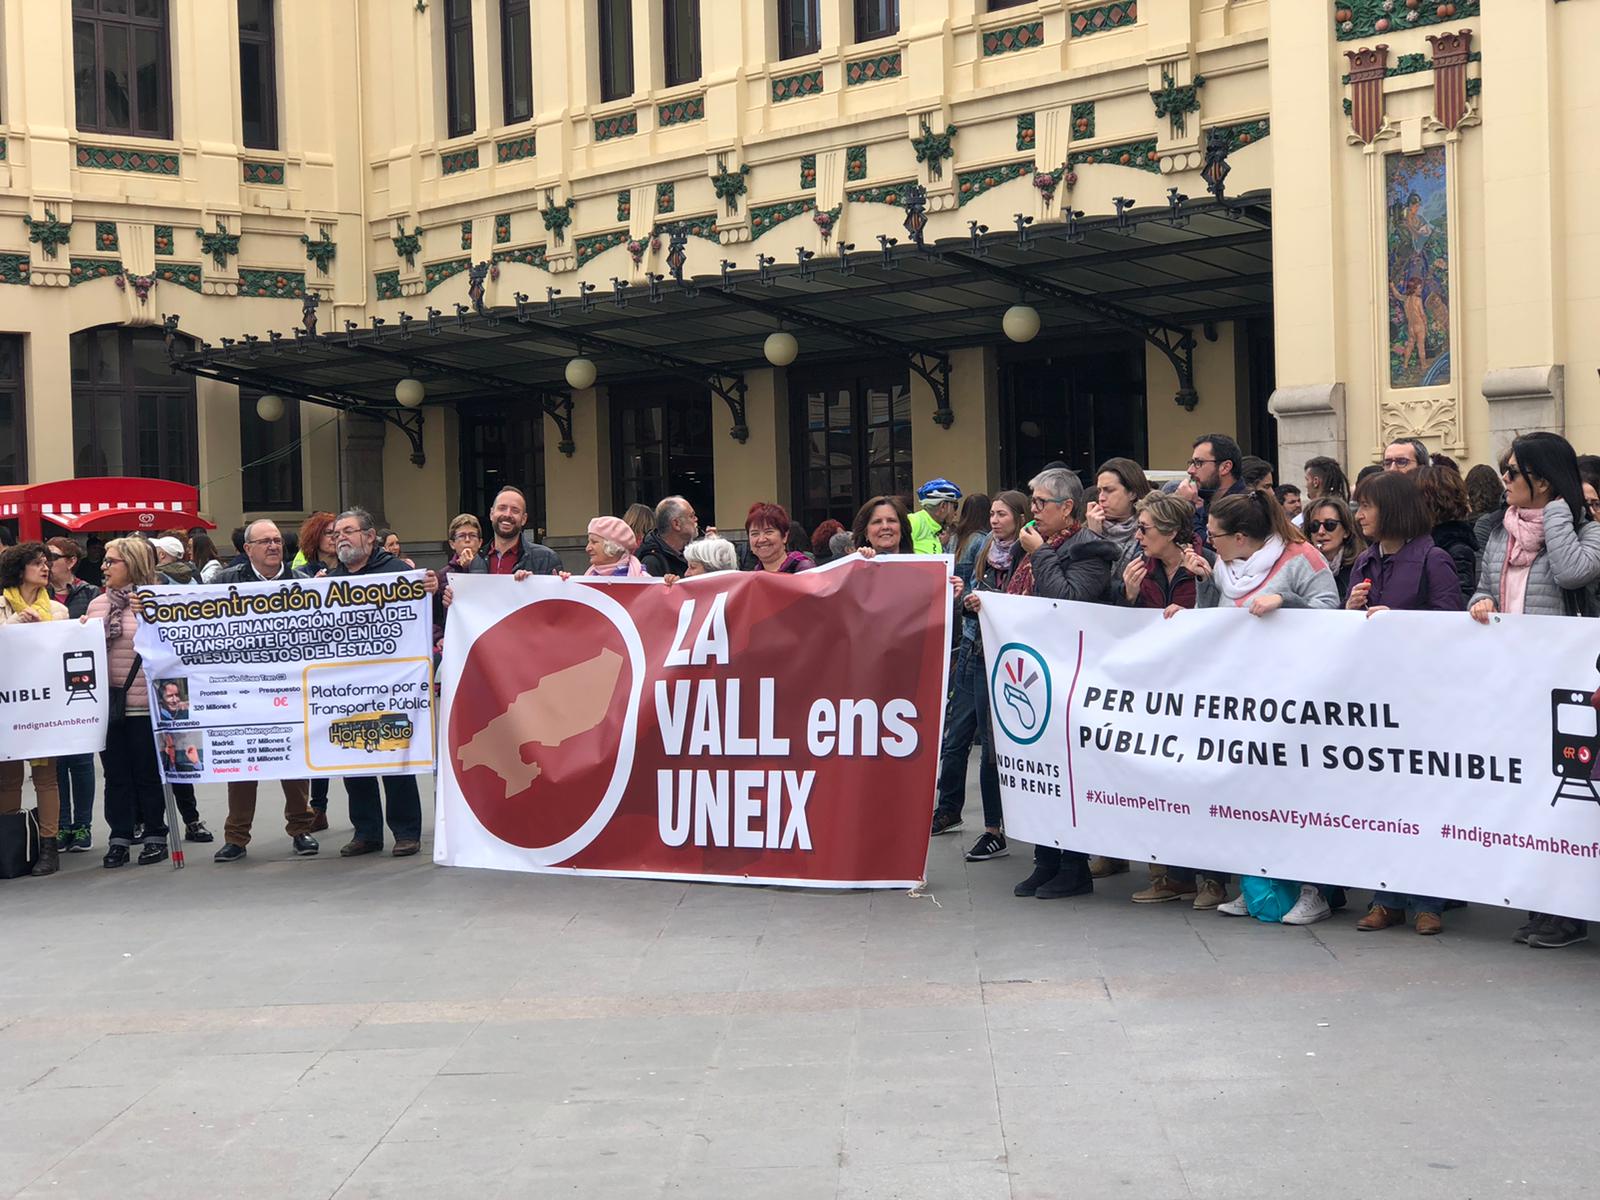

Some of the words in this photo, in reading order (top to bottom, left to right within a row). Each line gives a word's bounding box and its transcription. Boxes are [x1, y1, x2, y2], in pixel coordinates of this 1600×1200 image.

[140, 582, 321, 624] Concentración
[325, 576, 427, 609] Alaquàs
[159, 627, 190, 641] POR
[192, 623, 226, 640] UNA
[228, 611, 335, 637] FINANCIACIÓN
[337, 608, 385, 626] JUSTA
[386, 606, 417, 621] DEL
[174, 634, 278, 655] TRANSPORTE
[279, 628, 344, 649] PÚBLICO
[347, 625, 371, 641] EN
[372, 623, 401, 640] LOS
[662, 591, 730, 667] LA
[304, 646, 335, 661] DEL
[337, 639, 396, 656] ESTADO
[258, 686, 301, 694] Presupuesto
[311, 683, 389, 699] Plataforma
[392, 682, 416, 696] por
[308, 700, 386, 716] Transporte
[389, 697, 431, 711] Públic
[655, 677, 790, 755] VALL
[807, 698, 919, 757] ens
[1083, 687, 1135, 713] PER
[1145, 692, 1184, 716] UN
[1194, 695, 1399, 729] FERROCARRIL
[13, 716, 99, 731] #IndignatsAmbRenfe
[329, 726, 378, 743] Horta
[381, 723, 413, 740] Sud
[1079, 722, 1184, 763] PÚBLIC,
[1197, 737, 1288, 767] DIGNE
[1301, 744, 1310, 768] I
[1322, 745, 1522, 785] SOSTENIBLE
[1021, 778, 1062, 797] RENFE
[1086, 790, 1191, 815] #XiulemPelTren
[657, 768, 816, 850] UNEIX
[1209, 804, 1420, 835] #MenosAVEyMásCercanías
[1441, 823, 1600, 858] #IndignatsAmbRenf
